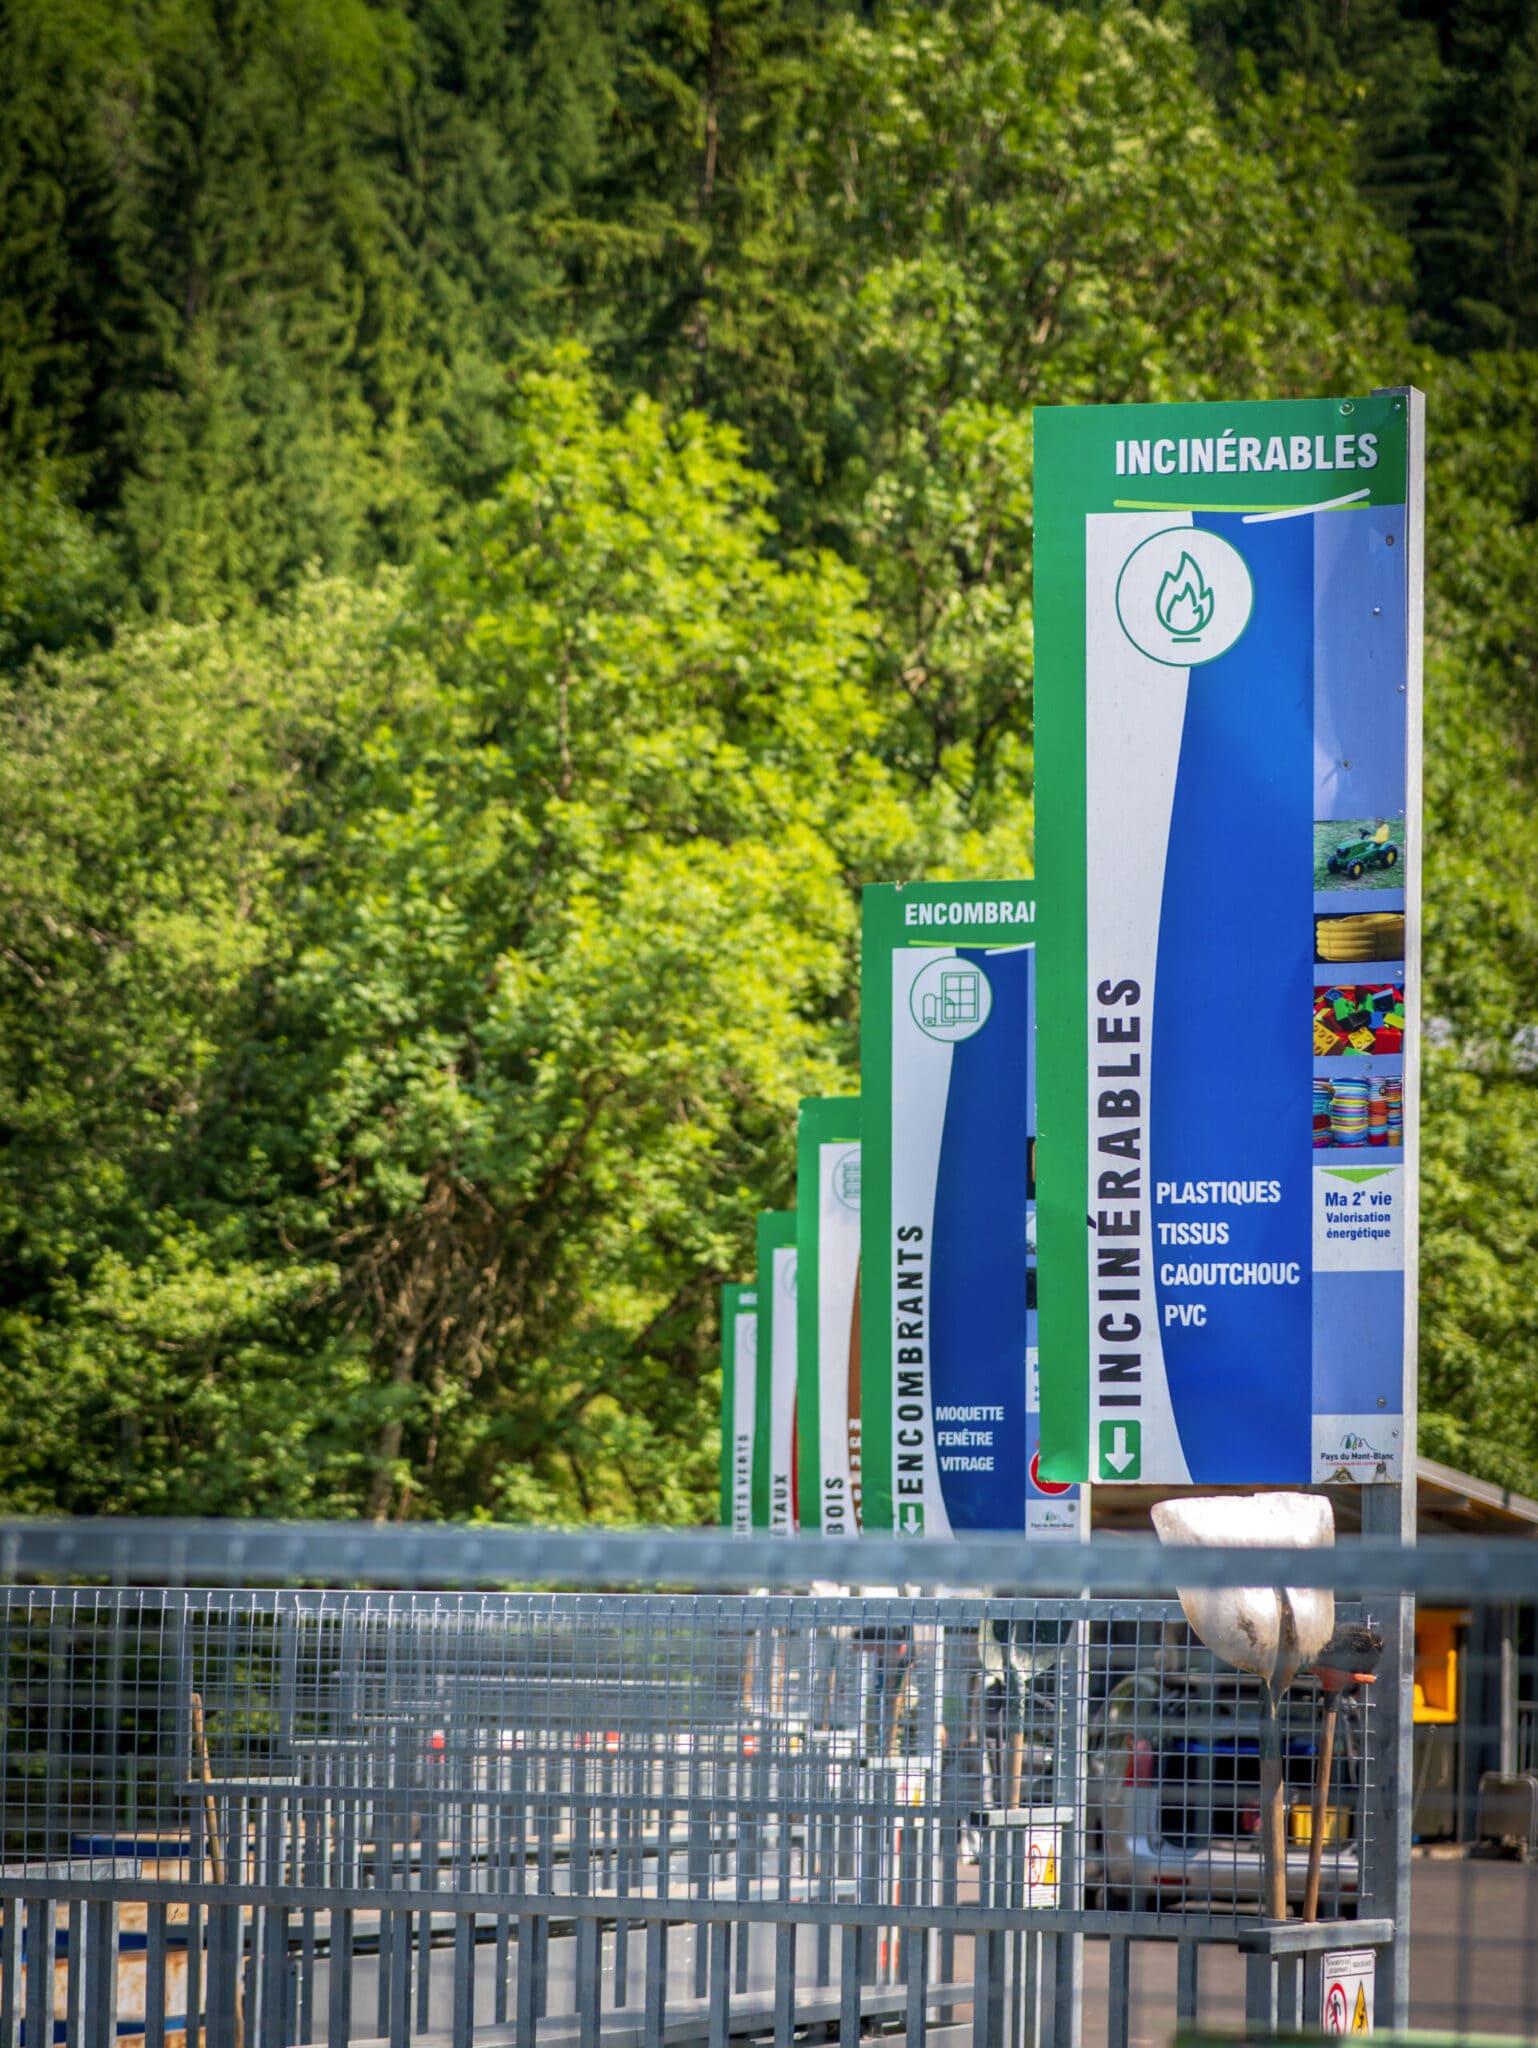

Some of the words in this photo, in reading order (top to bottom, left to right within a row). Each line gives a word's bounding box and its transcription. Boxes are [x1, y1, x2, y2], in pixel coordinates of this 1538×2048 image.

[1115, 428, 1379, 475] INCINÉRABLES
[1086, 978, 1142, 1407] INCINÉRABLES
[1156, 1180, 1281, 1205] PLASTIQUES
[1325, 1191, 1348, 1207] Ma
[1370, 1191, 1392, 1206] vie
[1326, 1211, 1391, 1223] Valorisation
[1157, 1222, 1230, 1245] TISSUS
[1326, 1227, 1391, 1240] énergétique
[1160, 1262, 1300, 1286] CAOUTCHOUC
[1164, 1304, 1207, 1327] PVC
[897, 1225, 924, 1494] ENCOMBRANTS
[935, 1406, 1004, 1422] MOQUETTE
[937, 1428, 994, 1446] FENÊTRE
[940, 1456, 995, 1471] VITRAGE
[1320, 1452, 1339, 1461] Pays
[1351, 1452, 1395, 1460] Mont-Blanc
[825, 1477, 844, 1535] BOIS
